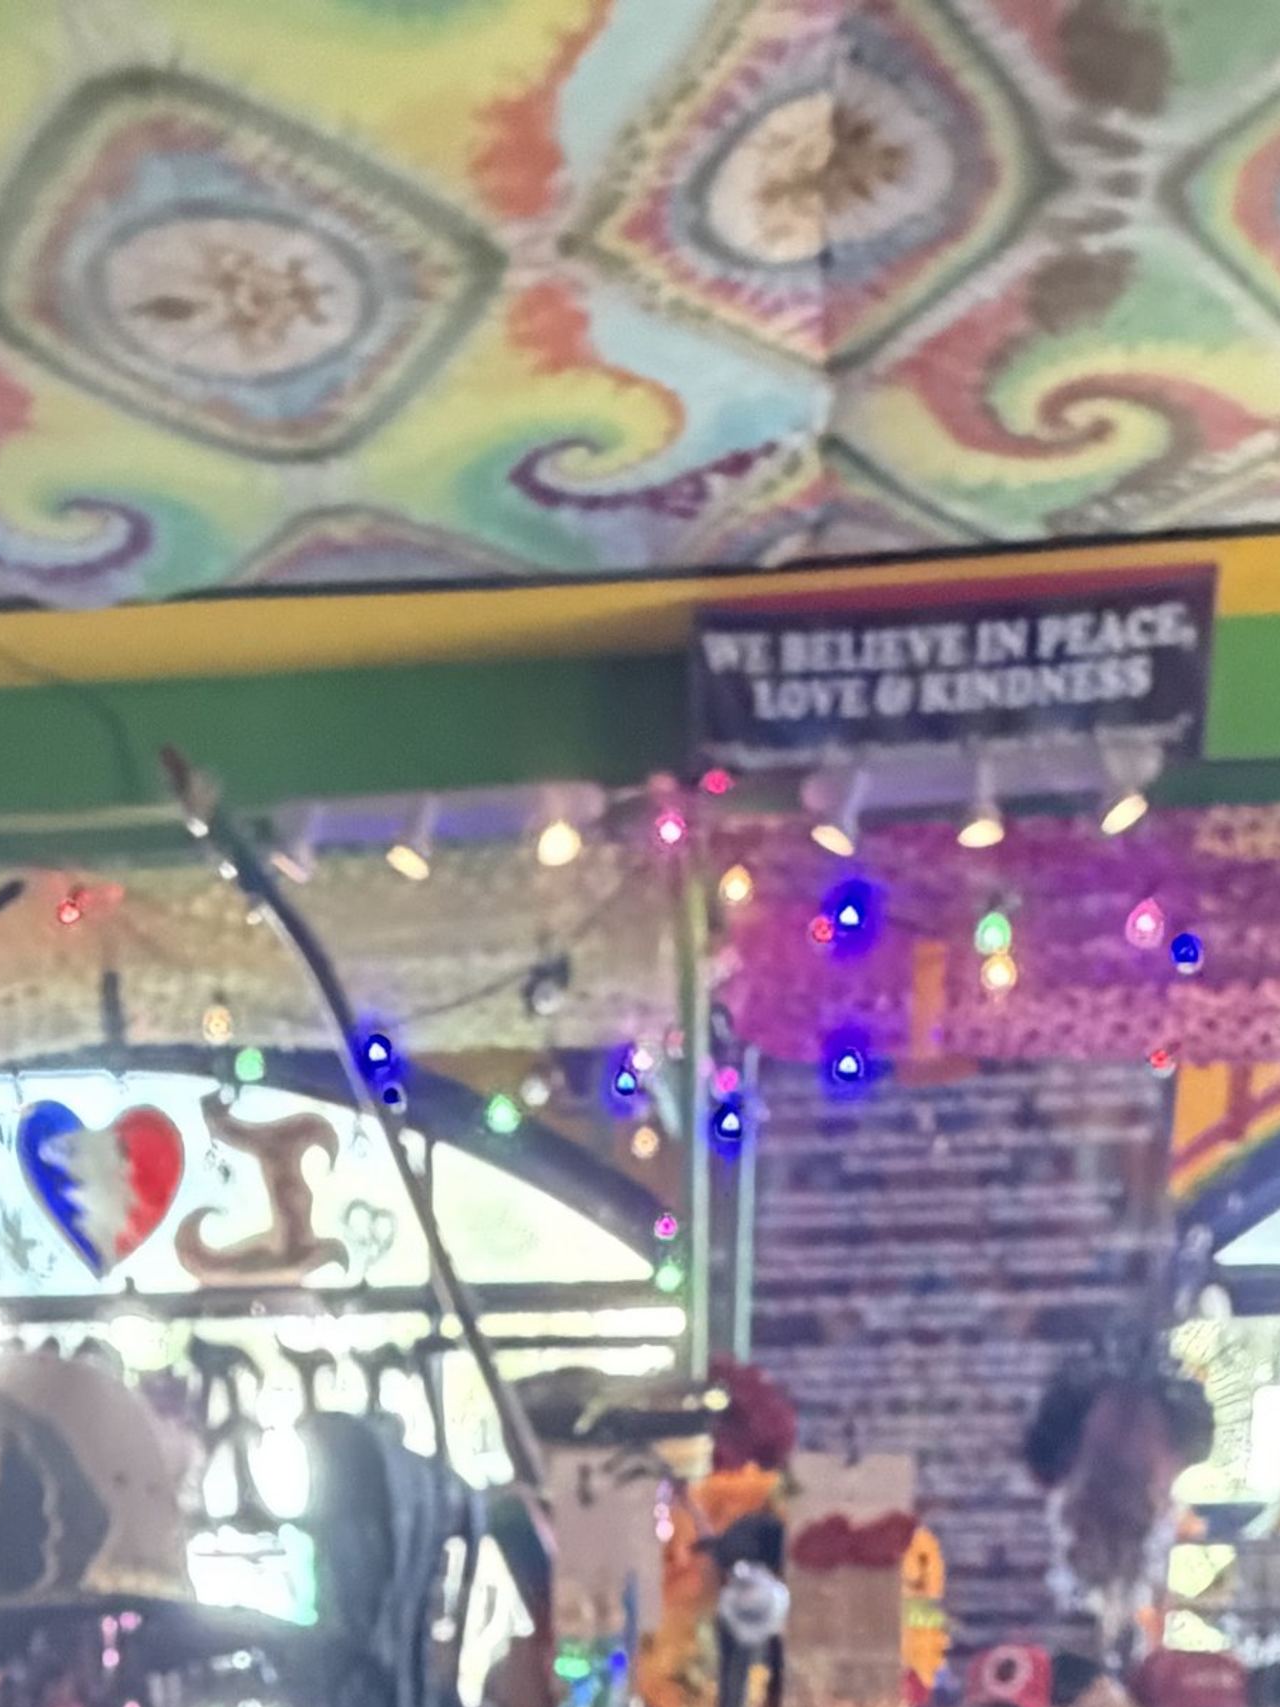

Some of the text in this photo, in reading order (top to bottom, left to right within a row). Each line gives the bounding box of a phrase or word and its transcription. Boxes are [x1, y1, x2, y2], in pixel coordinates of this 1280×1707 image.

[701, 604, 1199, 674] WE BELIEVE IN PEACE,
[752, 653, 1153, 721] LOVE & KINDNESS
